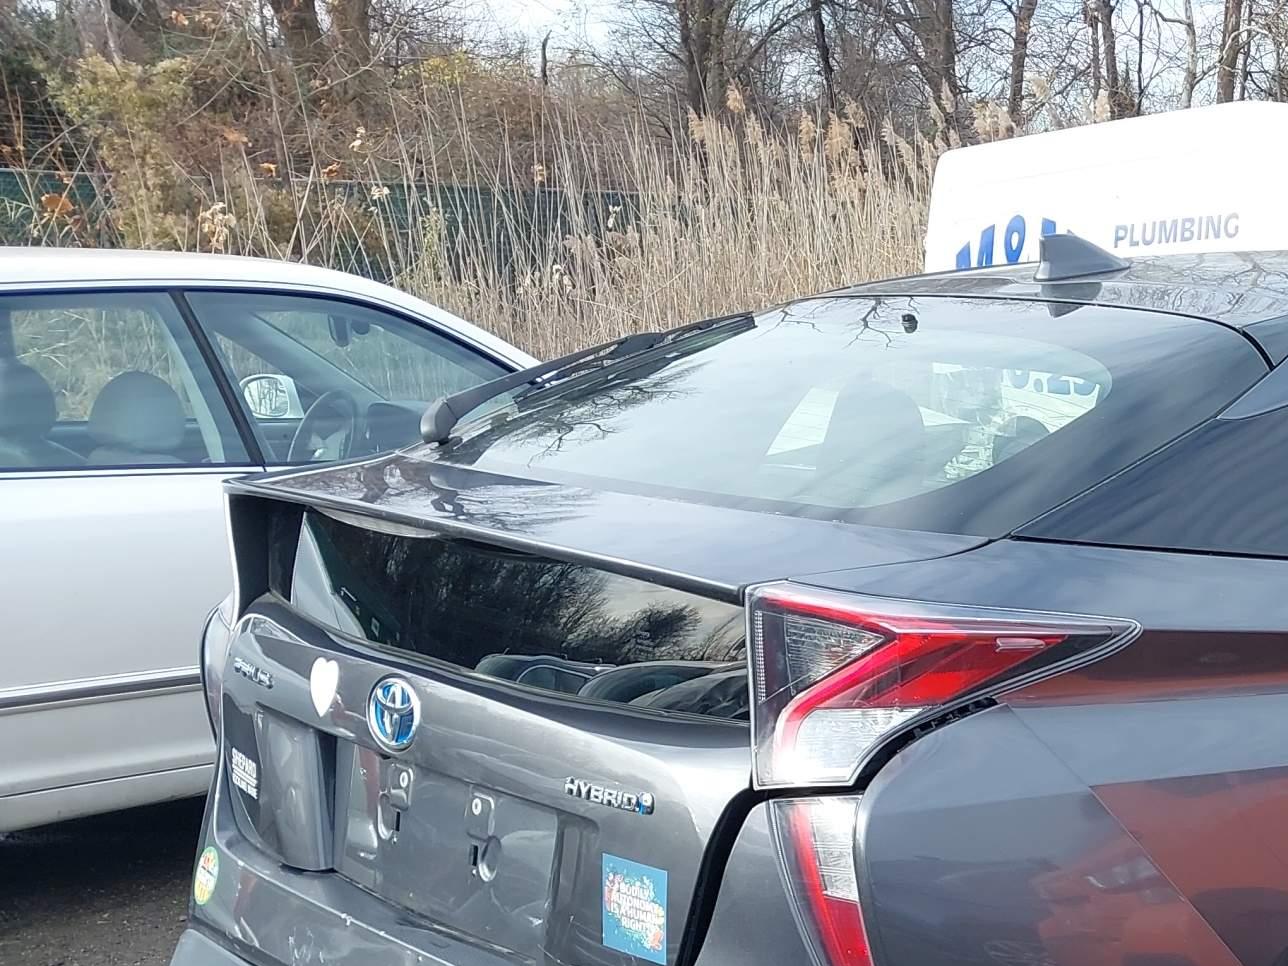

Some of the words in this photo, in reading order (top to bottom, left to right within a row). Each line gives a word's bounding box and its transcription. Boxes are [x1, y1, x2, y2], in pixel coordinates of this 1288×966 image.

[1113, 212, 1240, 248] PLUMBING
[564, 776, 638, 811] HYBRID
[619, 881, 650, 900] BODILY
